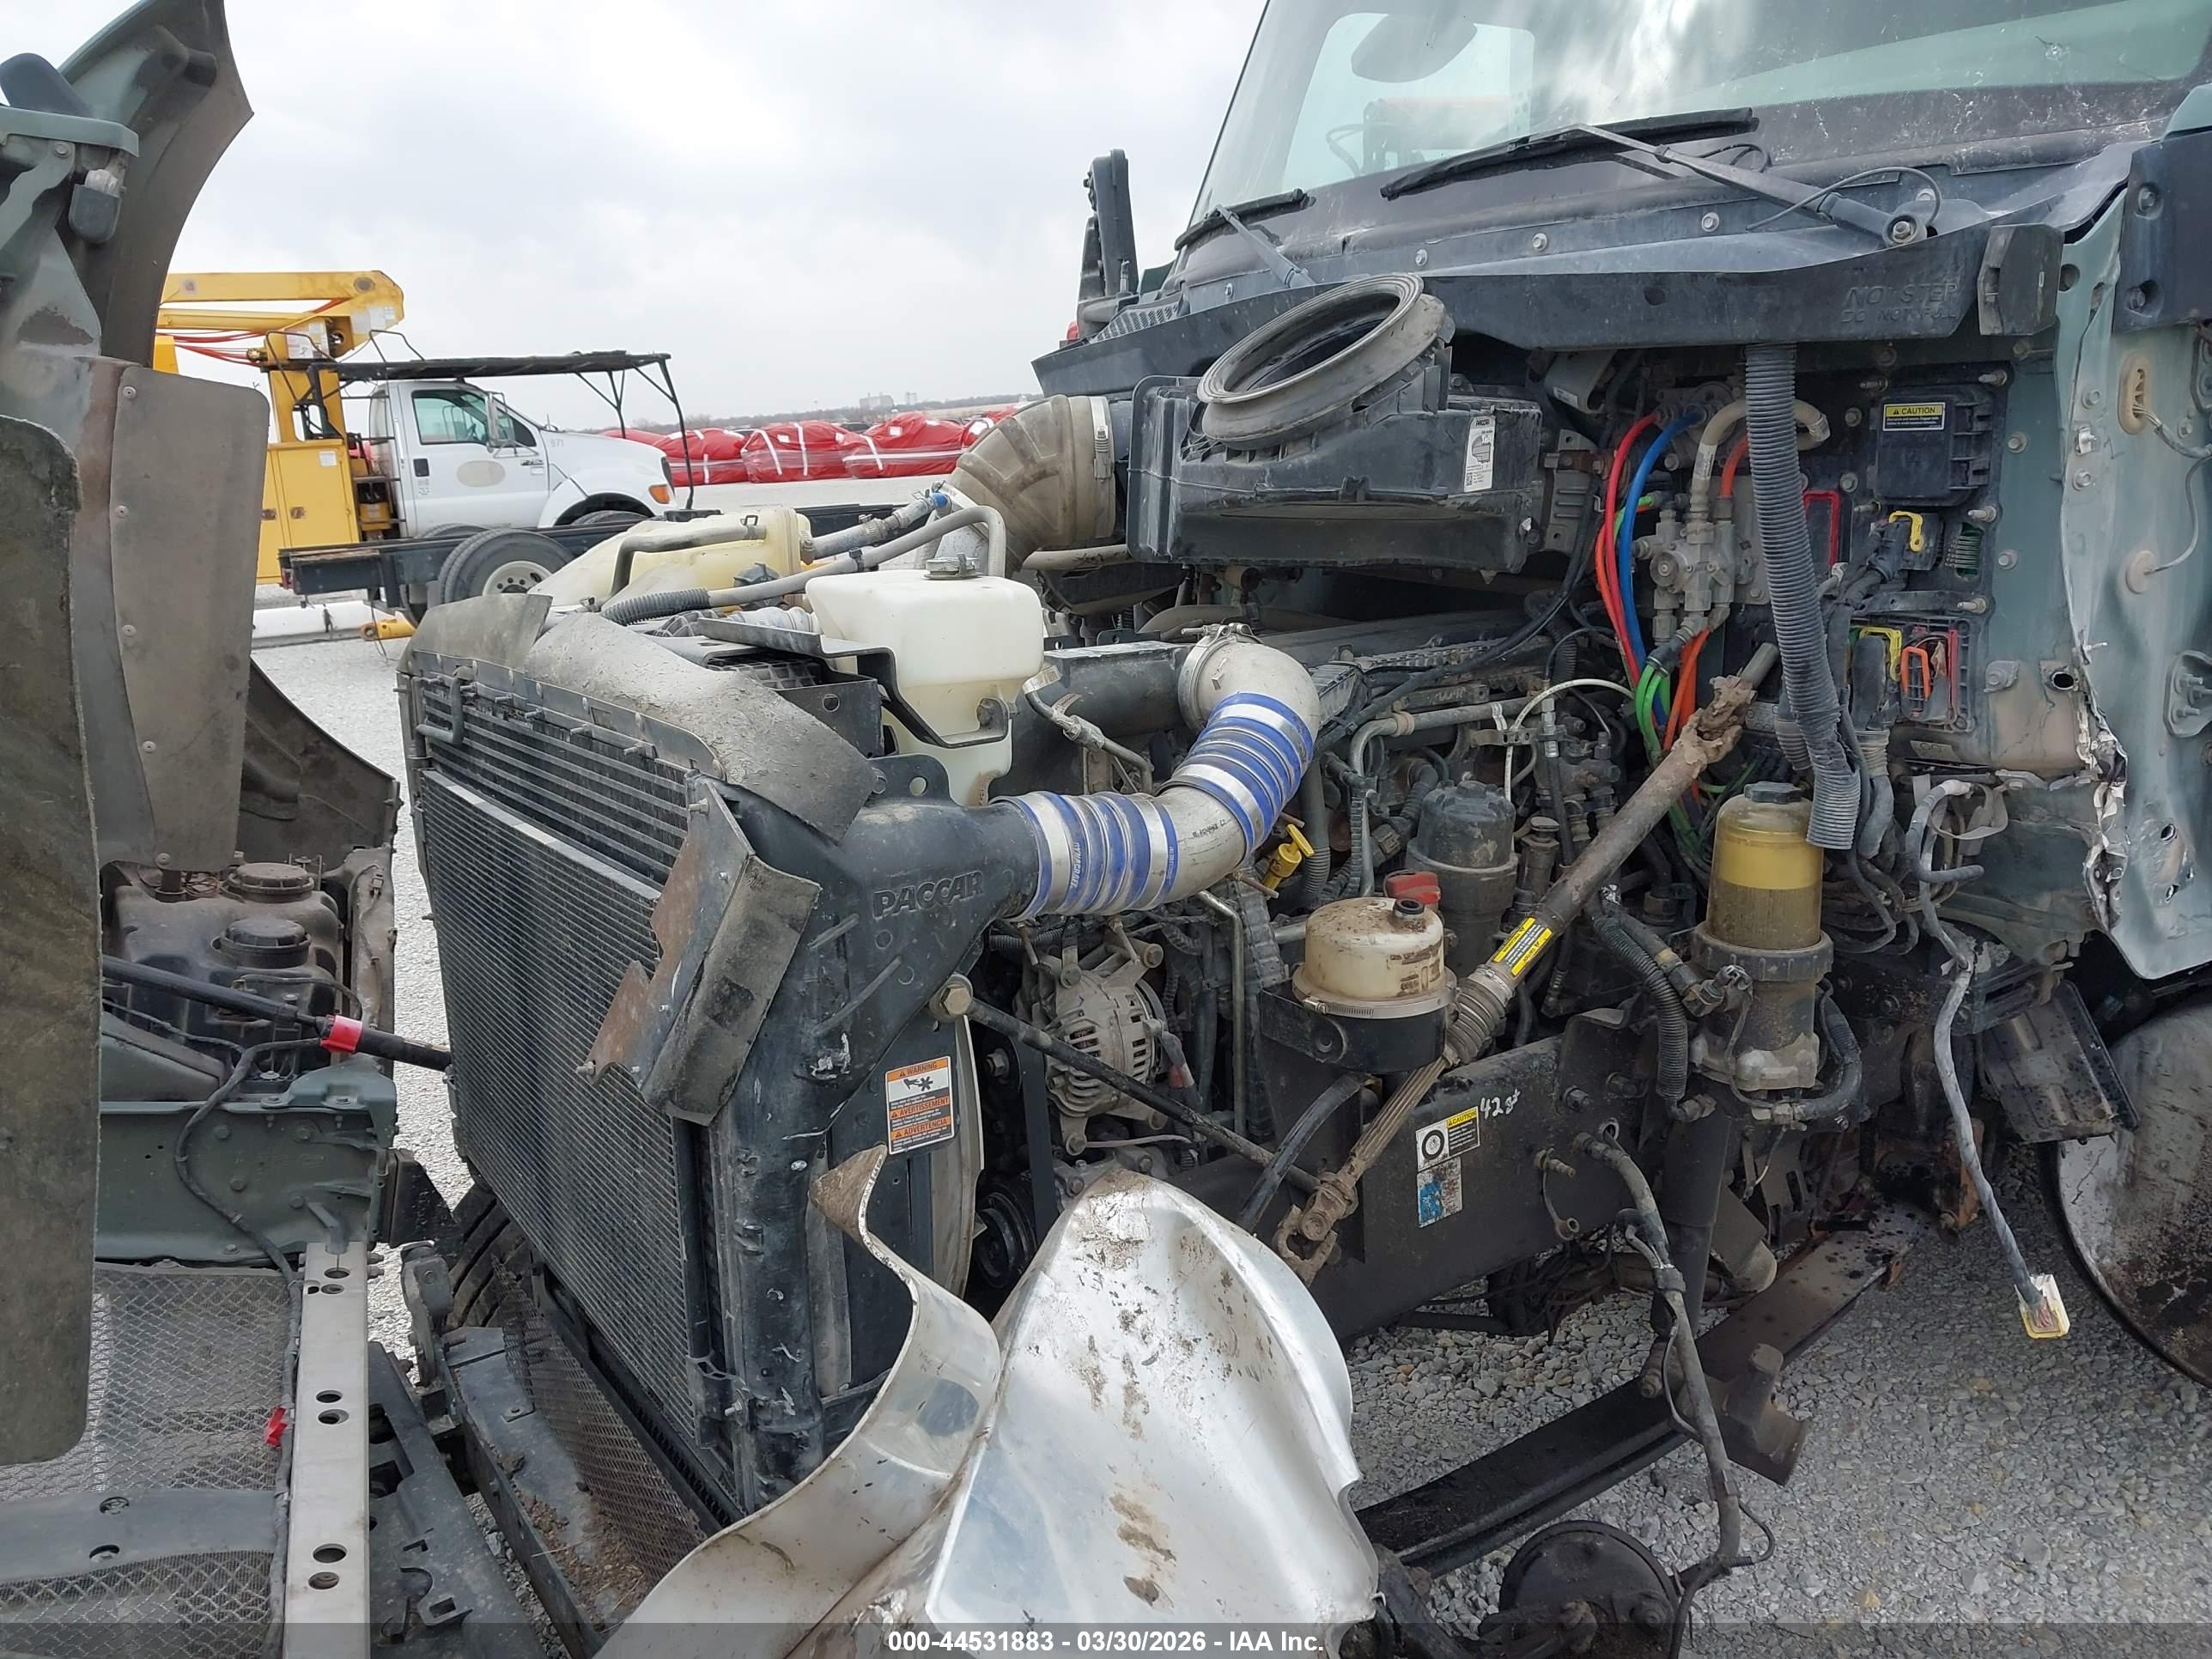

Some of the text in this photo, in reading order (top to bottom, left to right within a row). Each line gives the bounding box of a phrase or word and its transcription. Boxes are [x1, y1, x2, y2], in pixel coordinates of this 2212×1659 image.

[1843, 283, 1958, 307] NO STEP
[1900, 406, 1936, 416] CAUTION
[872, 869, 985, 922] PACCAR
[906, 1061, 938, 1076] WARNING
[899, 1097, 950, 1116] AVERTISSEMENT
[903, 1118, 949, 1136] ADVERTENCIA
[1451, 1110, 1478, 1126] CAUTION
